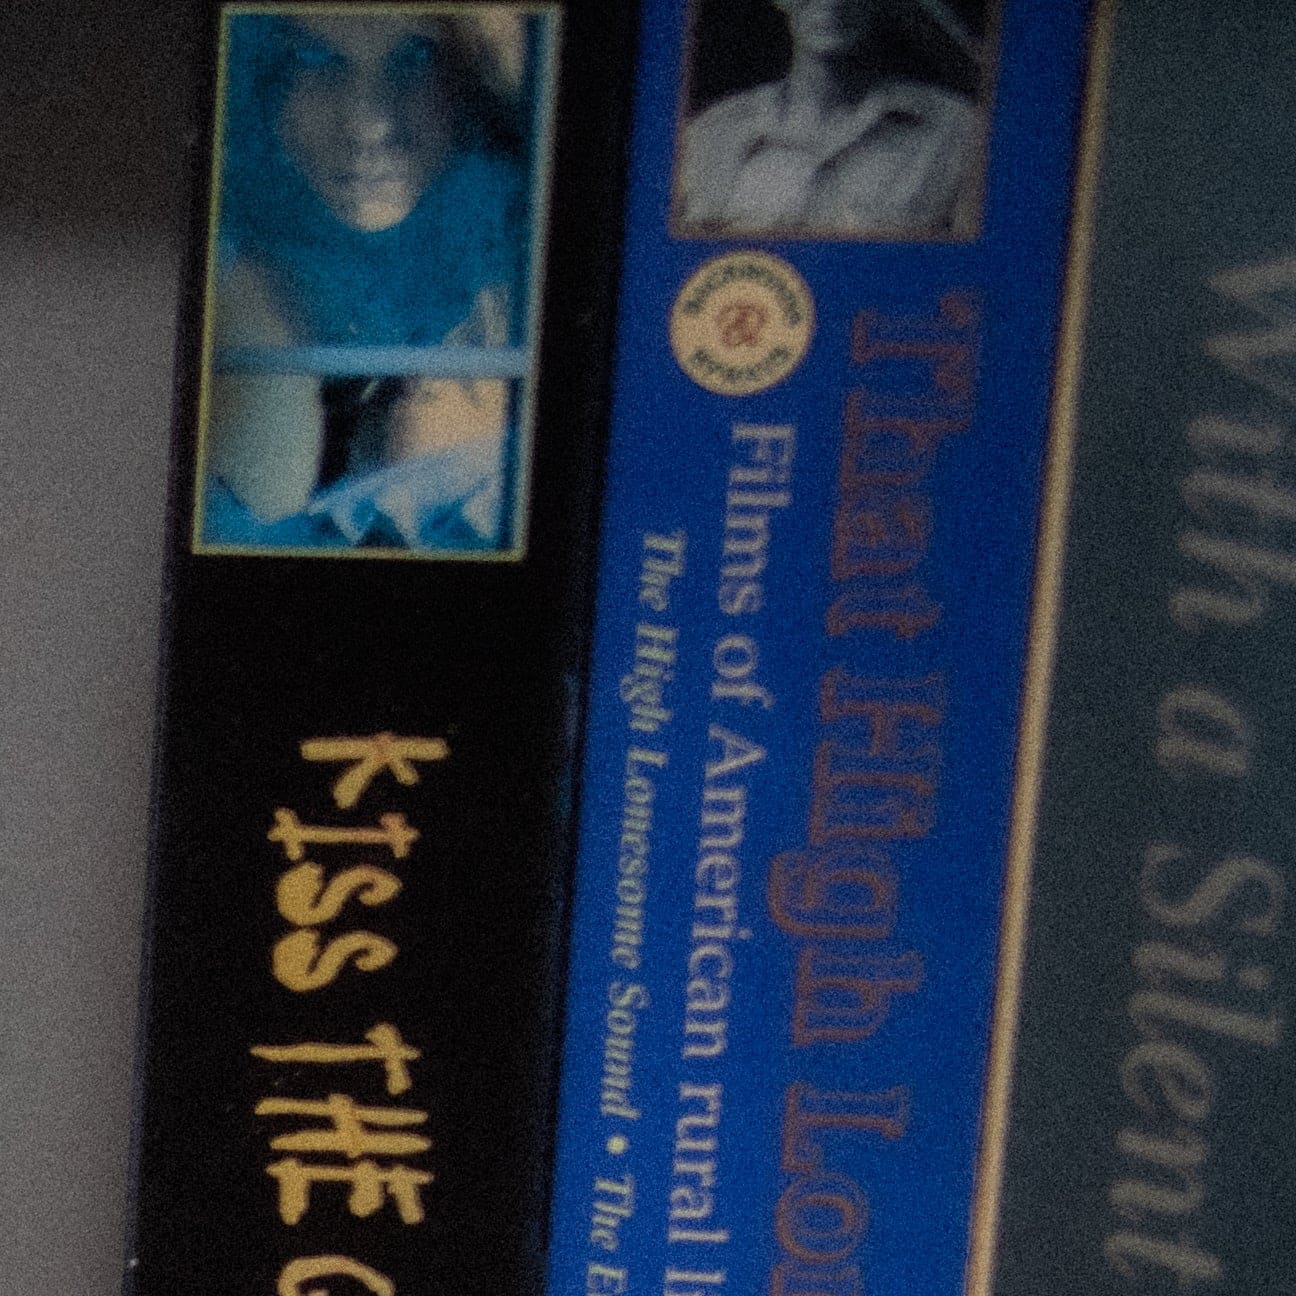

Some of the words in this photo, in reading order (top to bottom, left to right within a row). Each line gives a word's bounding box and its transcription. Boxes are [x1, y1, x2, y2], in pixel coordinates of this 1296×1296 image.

[717, 423, 797, 615] Films
[824, 288, 983, 638] That
[1169, 255, 1296, 631] With
[638, 529, 688, 612] The
[619, 622, 681, 734] High
[711, 633, 777, 711] of
[1153, 684, 1253, 780] a
[265, 731, 452, 994] KISS
[610, 745, 670, 970] Lonesome
[681, 723, 769, 1057] American
[766, 664, 948, 1049] High
[249, 1022, 435, 1227] THE
[599, 981, 651, 1121] Sound
[1103, 839, 1287, 1287] Silent
[590, 1173, 637, 1252] The
[667, 1082, 731, 1244] rural
